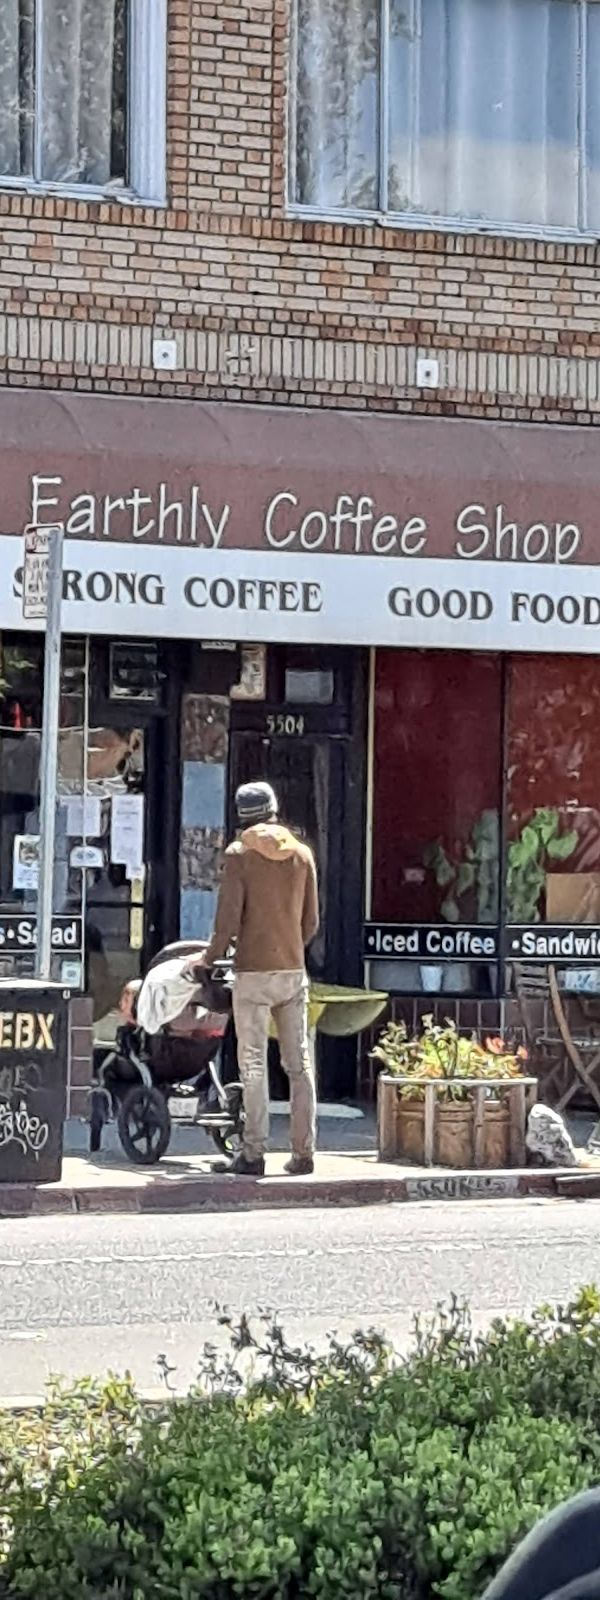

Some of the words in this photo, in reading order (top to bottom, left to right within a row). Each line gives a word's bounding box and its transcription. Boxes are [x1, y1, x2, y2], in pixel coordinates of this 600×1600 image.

[31, 475, 230, 548] Earthly
[265, 492, 427, 555] Coffee
[456, 504, 580, 563] Shop
[13, 566, 165, 605] SRONG
[184, 576, 323, 612] COFFEE
[388, 586, 493, 621] GOOD
[511, 592, 600, 625] FOOD
[265, 714, 305, 737] 5504
[376, 930, 419, 952] Iced
[426, 931, 496, 955] Coffee
